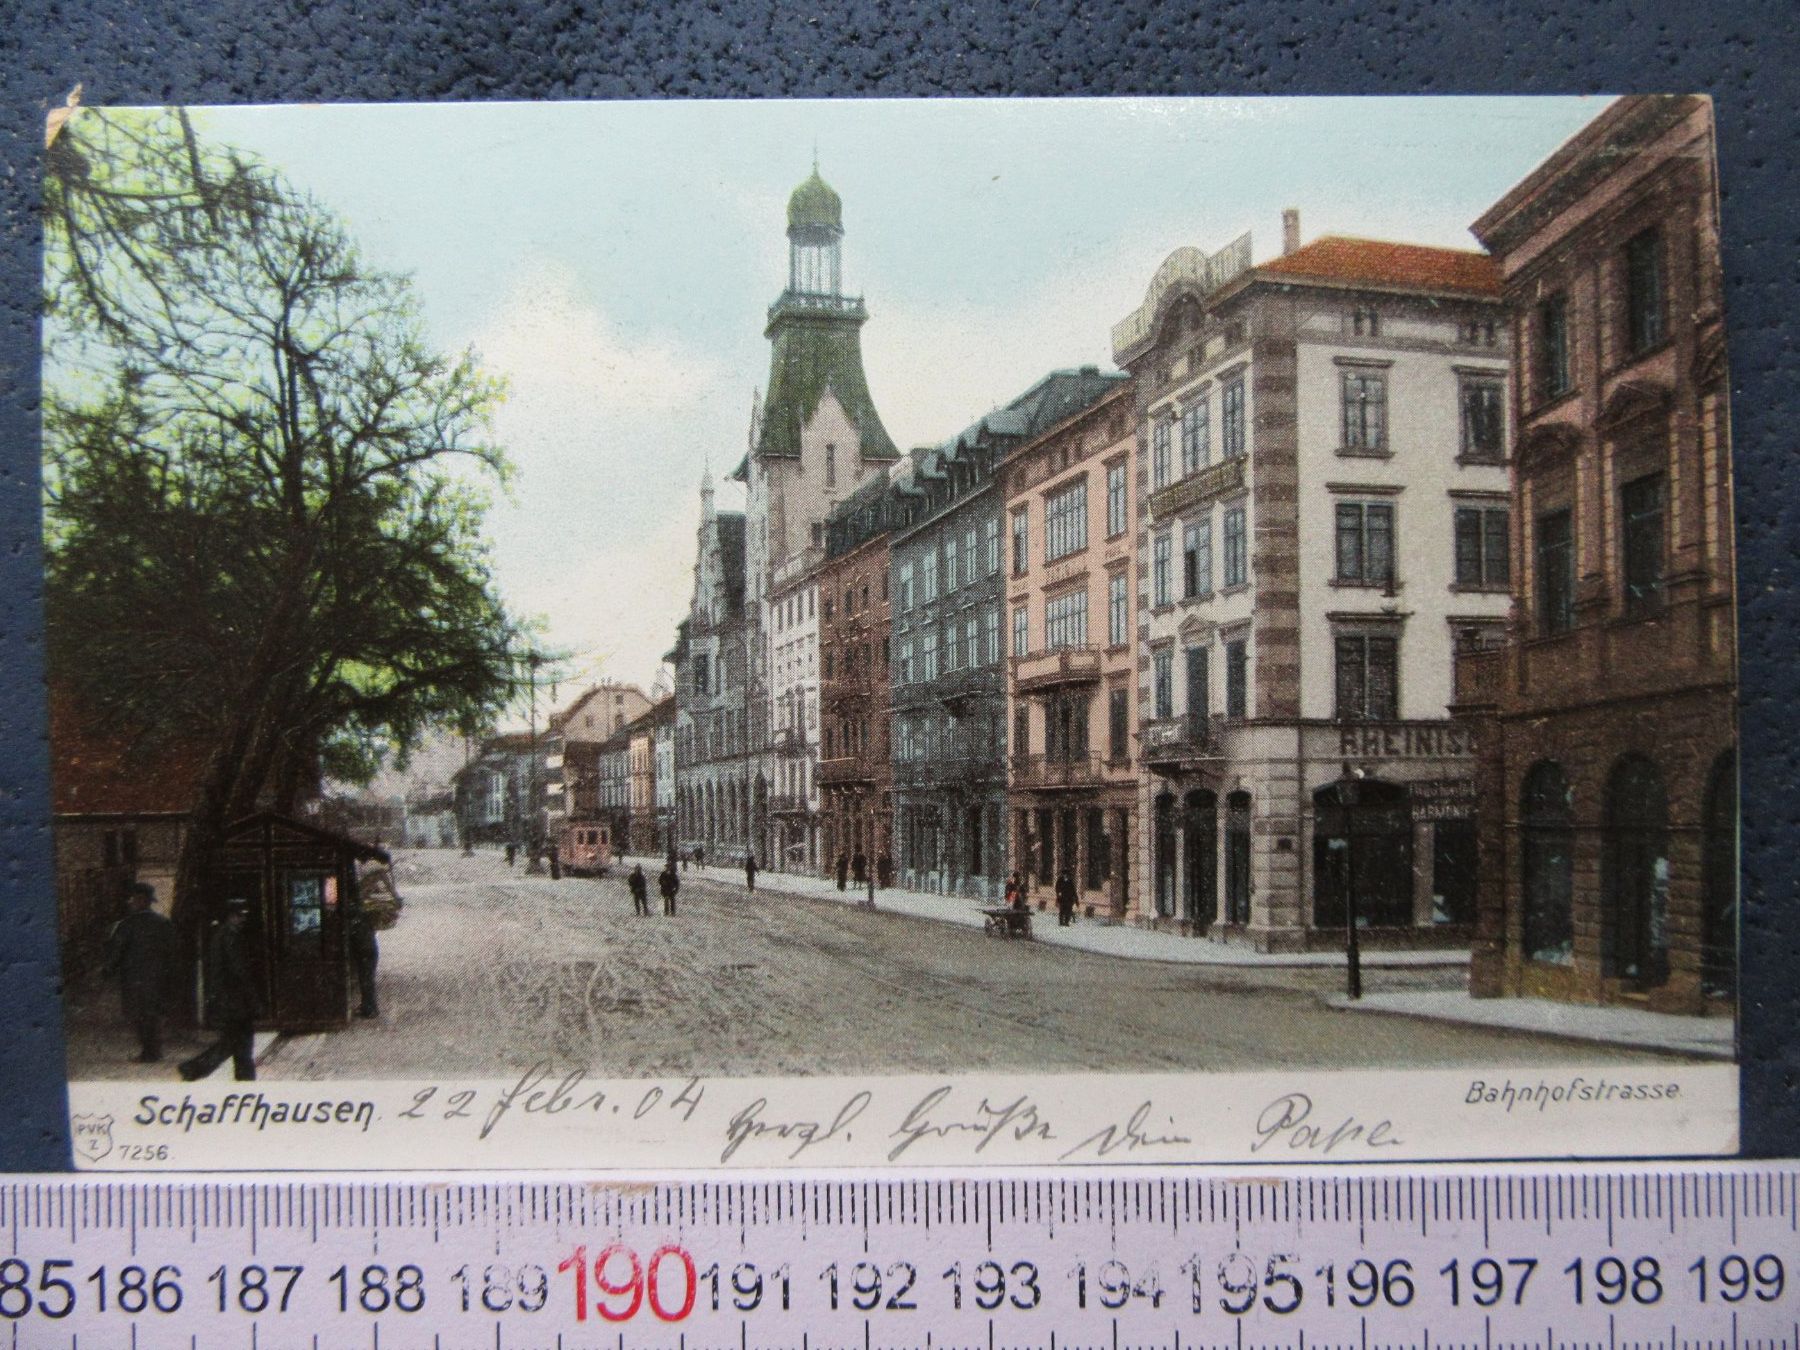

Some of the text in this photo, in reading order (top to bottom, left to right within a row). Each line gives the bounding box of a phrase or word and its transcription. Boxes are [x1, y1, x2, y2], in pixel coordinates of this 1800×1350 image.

[634, 1074, 705, 1121] 04
[88, 1264, 184, 1314] 186
[207, 1263, 305, 1314] 187
[328, 1263, 427, 1314] 188
[450, 1262, 549, 1313] 189
[557, 1244, 698, 1322] 190
[700, 1262, 790, 1312] 191
[818, 1261, 918, 1312] 192
[942, 1259, 1042, 1312] 193
[1068, 1259, 1166, 1311] 194
[1179, 1252, 1304, 1316] 195
[1314, 1258, 1416, 1309] 196
[1439, 1257, 1539, 1308] 197
[1563, 1256, 1664, 1306] 198
[1687, 1254, 1786, 1304] 199
